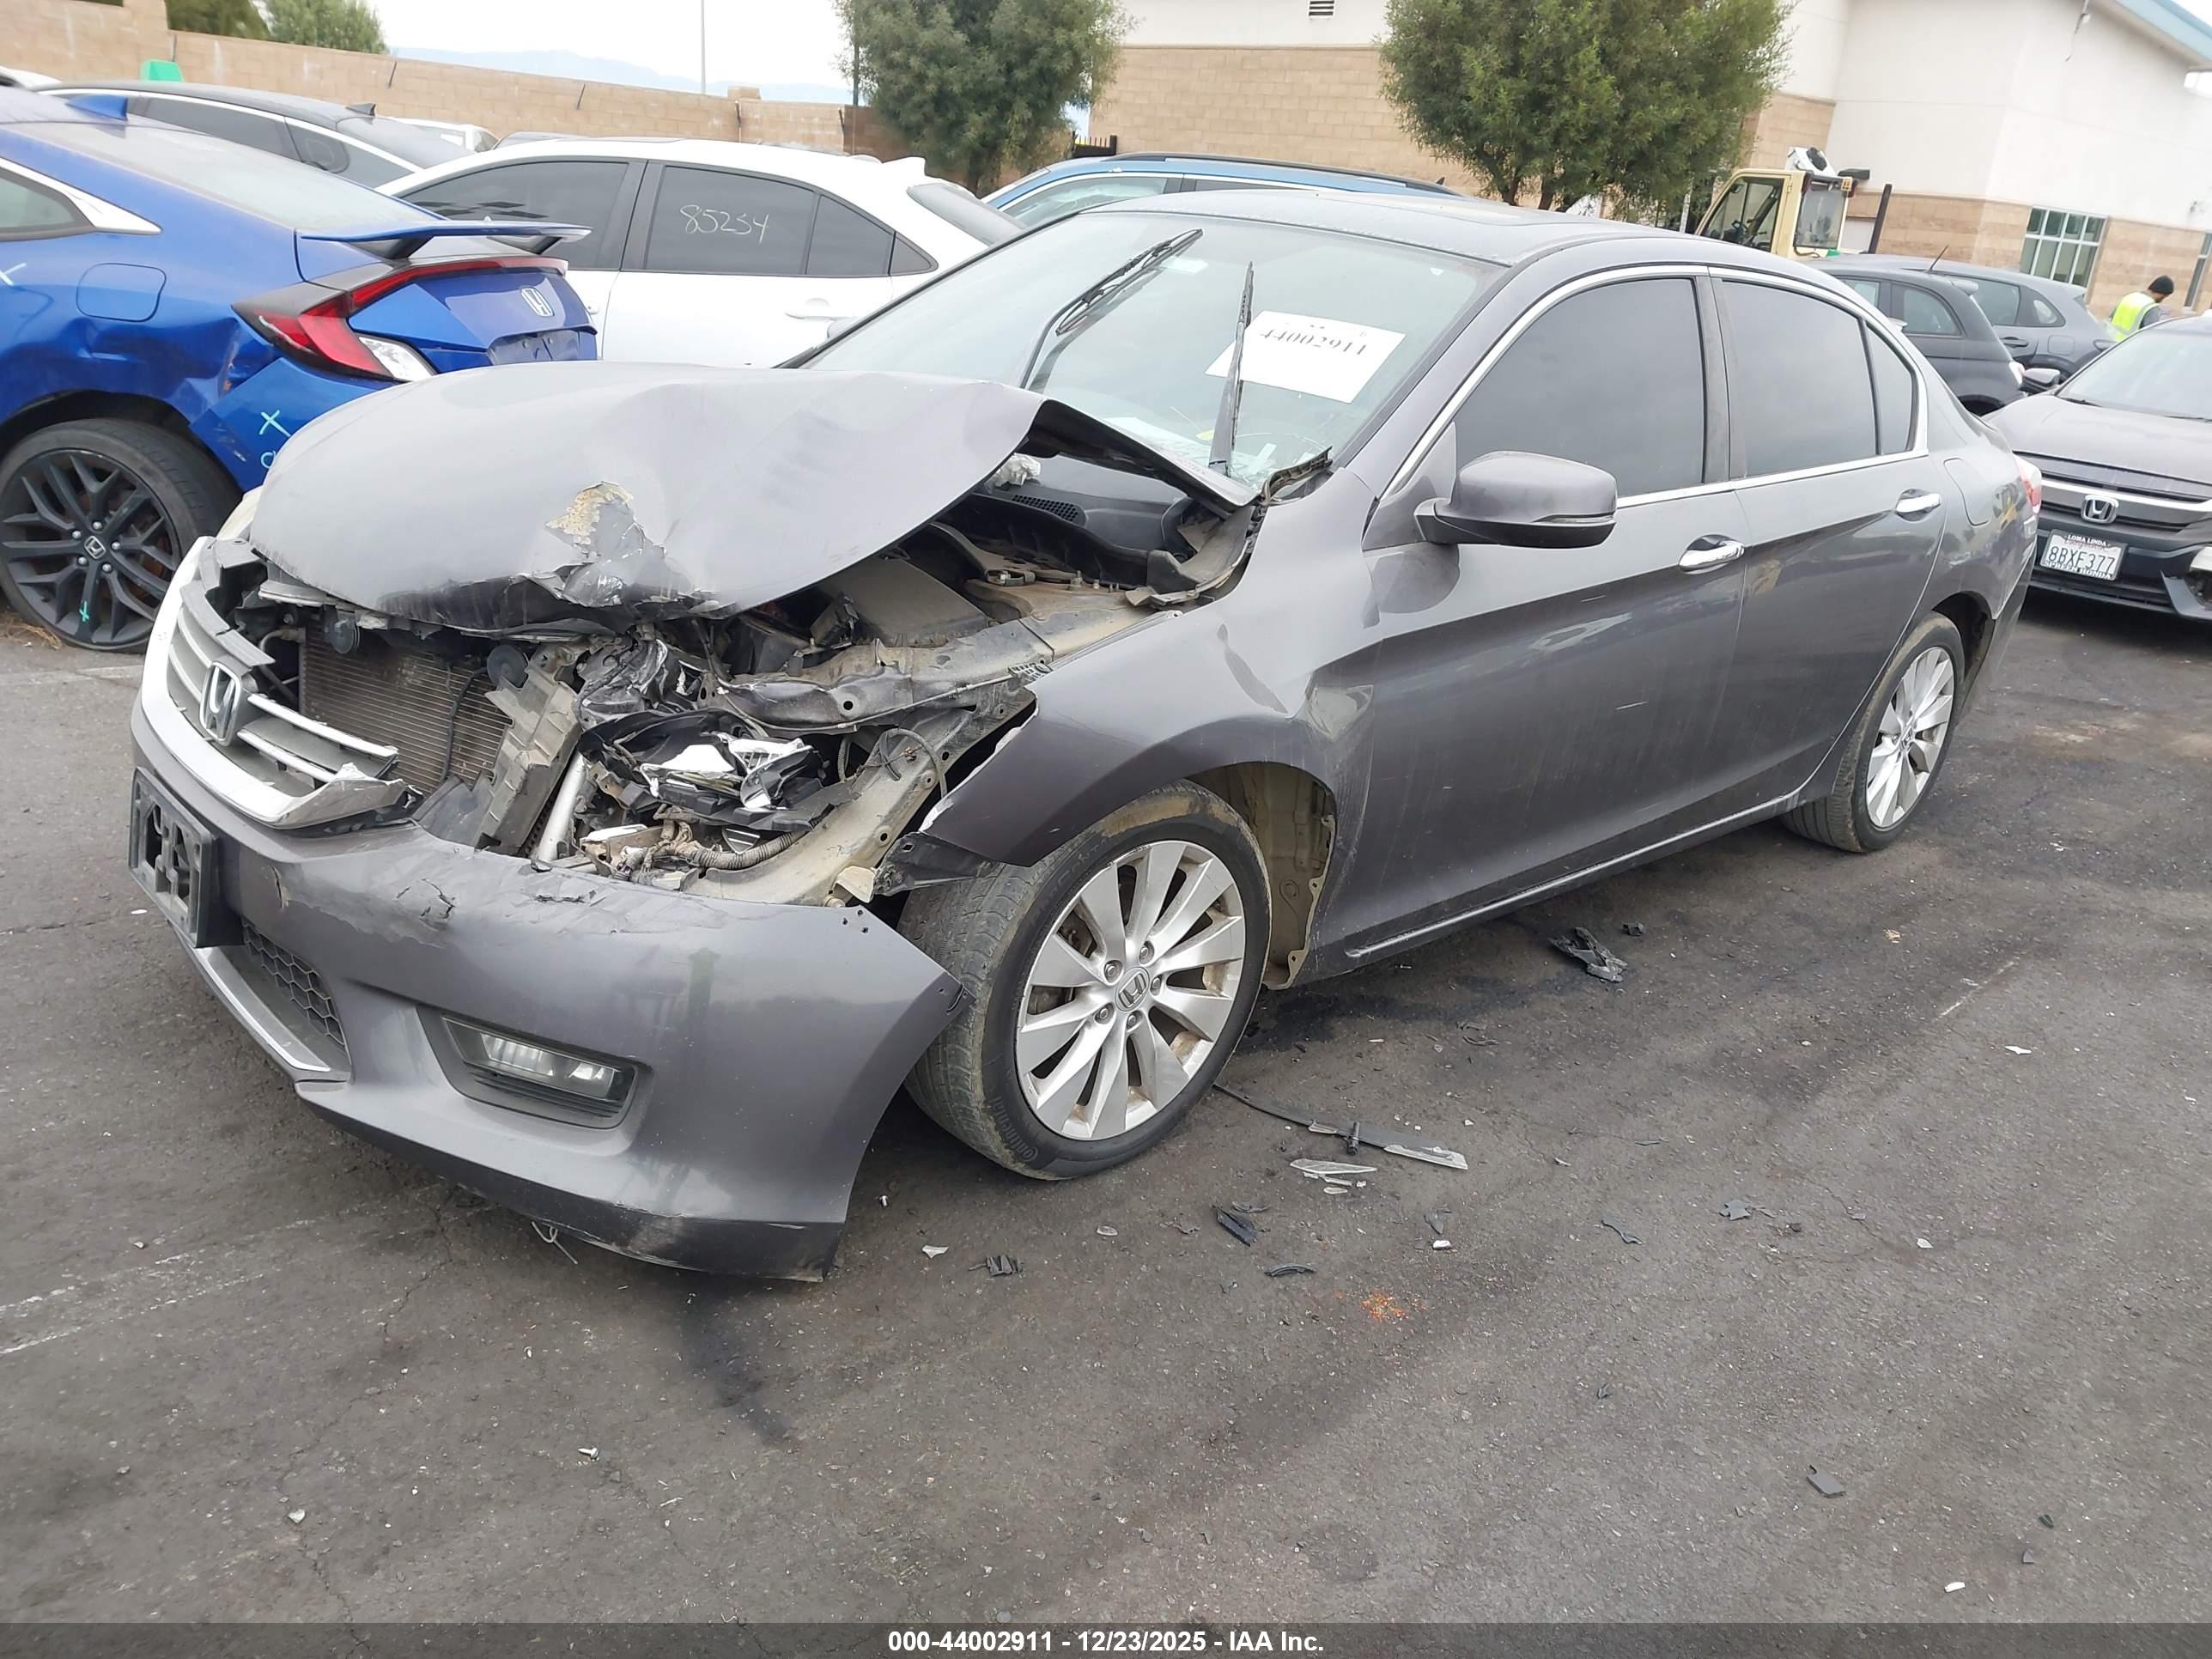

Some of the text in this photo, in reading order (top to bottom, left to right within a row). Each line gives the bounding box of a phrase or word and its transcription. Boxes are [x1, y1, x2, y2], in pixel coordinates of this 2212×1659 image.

[680, 204, 769, 244] 85254
[2067, 534, 2087, 544] LOMA
[2087, 538, 2106, 547] LINDA
[2048, 545, 2116, 575] 8BXF377
